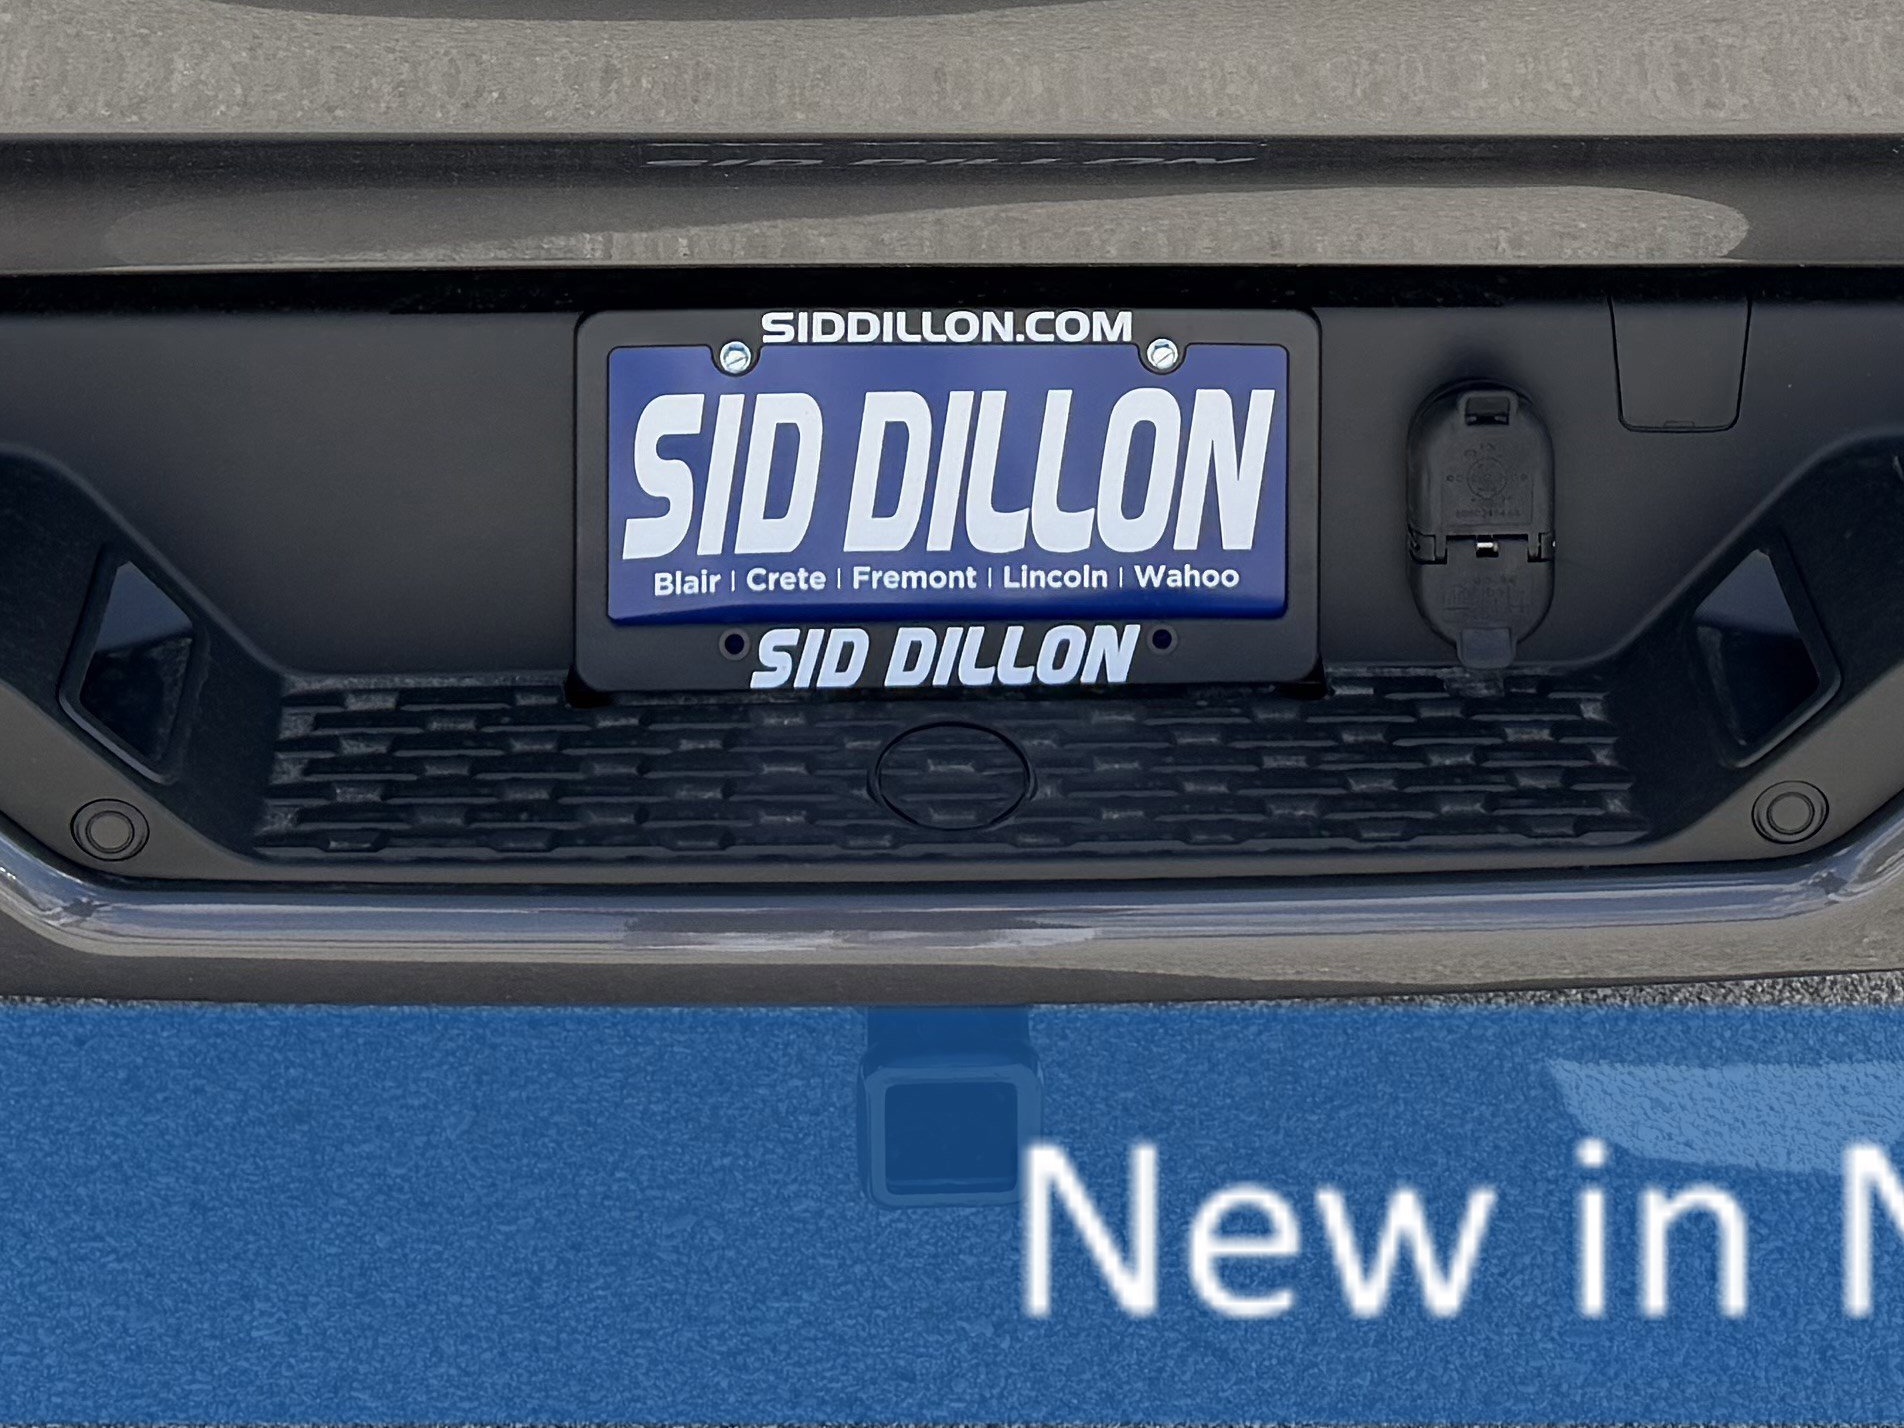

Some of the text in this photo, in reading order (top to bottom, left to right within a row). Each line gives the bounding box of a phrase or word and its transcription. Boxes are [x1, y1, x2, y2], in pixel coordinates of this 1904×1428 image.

[761, 309, 1133, 344] SIDDILLON.COM
[622, 387, 1276, 560] SID DILLON
[653, 562, 1240, 597] Blair Crete Fremont Lincoln Wahoo
[749, 623, 1141, 689] SID DILLON
